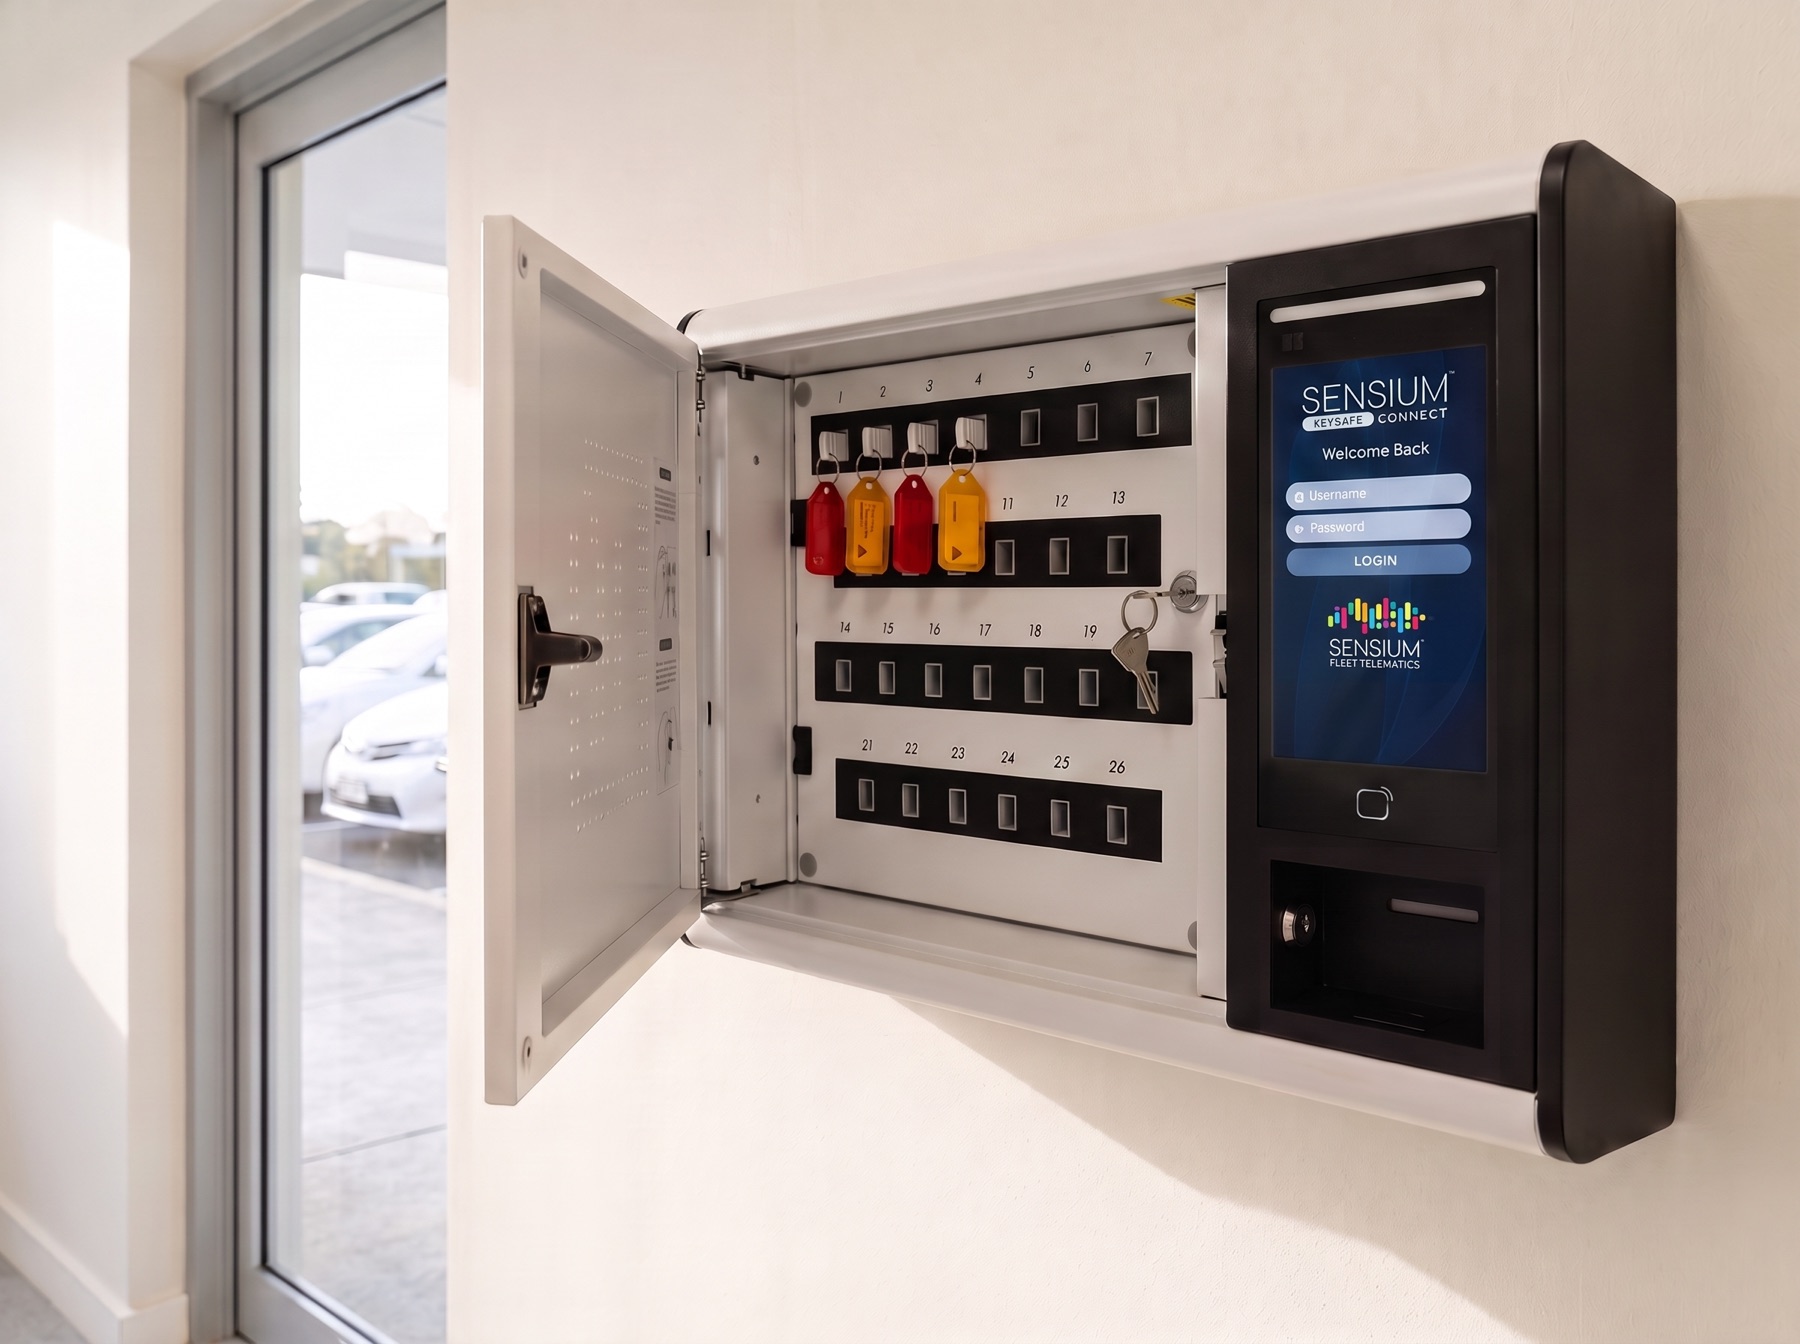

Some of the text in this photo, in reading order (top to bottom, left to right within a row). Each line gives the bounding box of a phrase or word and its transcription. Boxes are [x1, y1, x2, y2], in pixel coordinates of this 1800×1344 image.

[879, 385, 887, 398] 2
[925, 379, 934, 393] 3
[974, 372, 982, 386] 4
[1026, 365, 1035, 380] 5
[1084, 360, 1091, 373] 6
[1144, 351, 1153, 366] 7
[1301, 373, 1448, 414] SENSIUM
[1313, 407, 1448, 429] KEYSAFE CONNECT
[1322, 441, 1430, 461] Welcome Back
[1002, 490, 1126, 511] 11 12 13
[1309, 489, 1367, 502] Username
[1310, 520, 1365, 534] Password
[1354, 554, 1397, 567] LOGIN
[840, 621, 1098, 639] 14 15 16 17 18 19
[1329, 638, 1420, 658] SENSIUM
[1329, 658, 1421, 670] FLEET TELEMATICS
[861, 738, 1126, 774] 21 22 23 24 25 26
